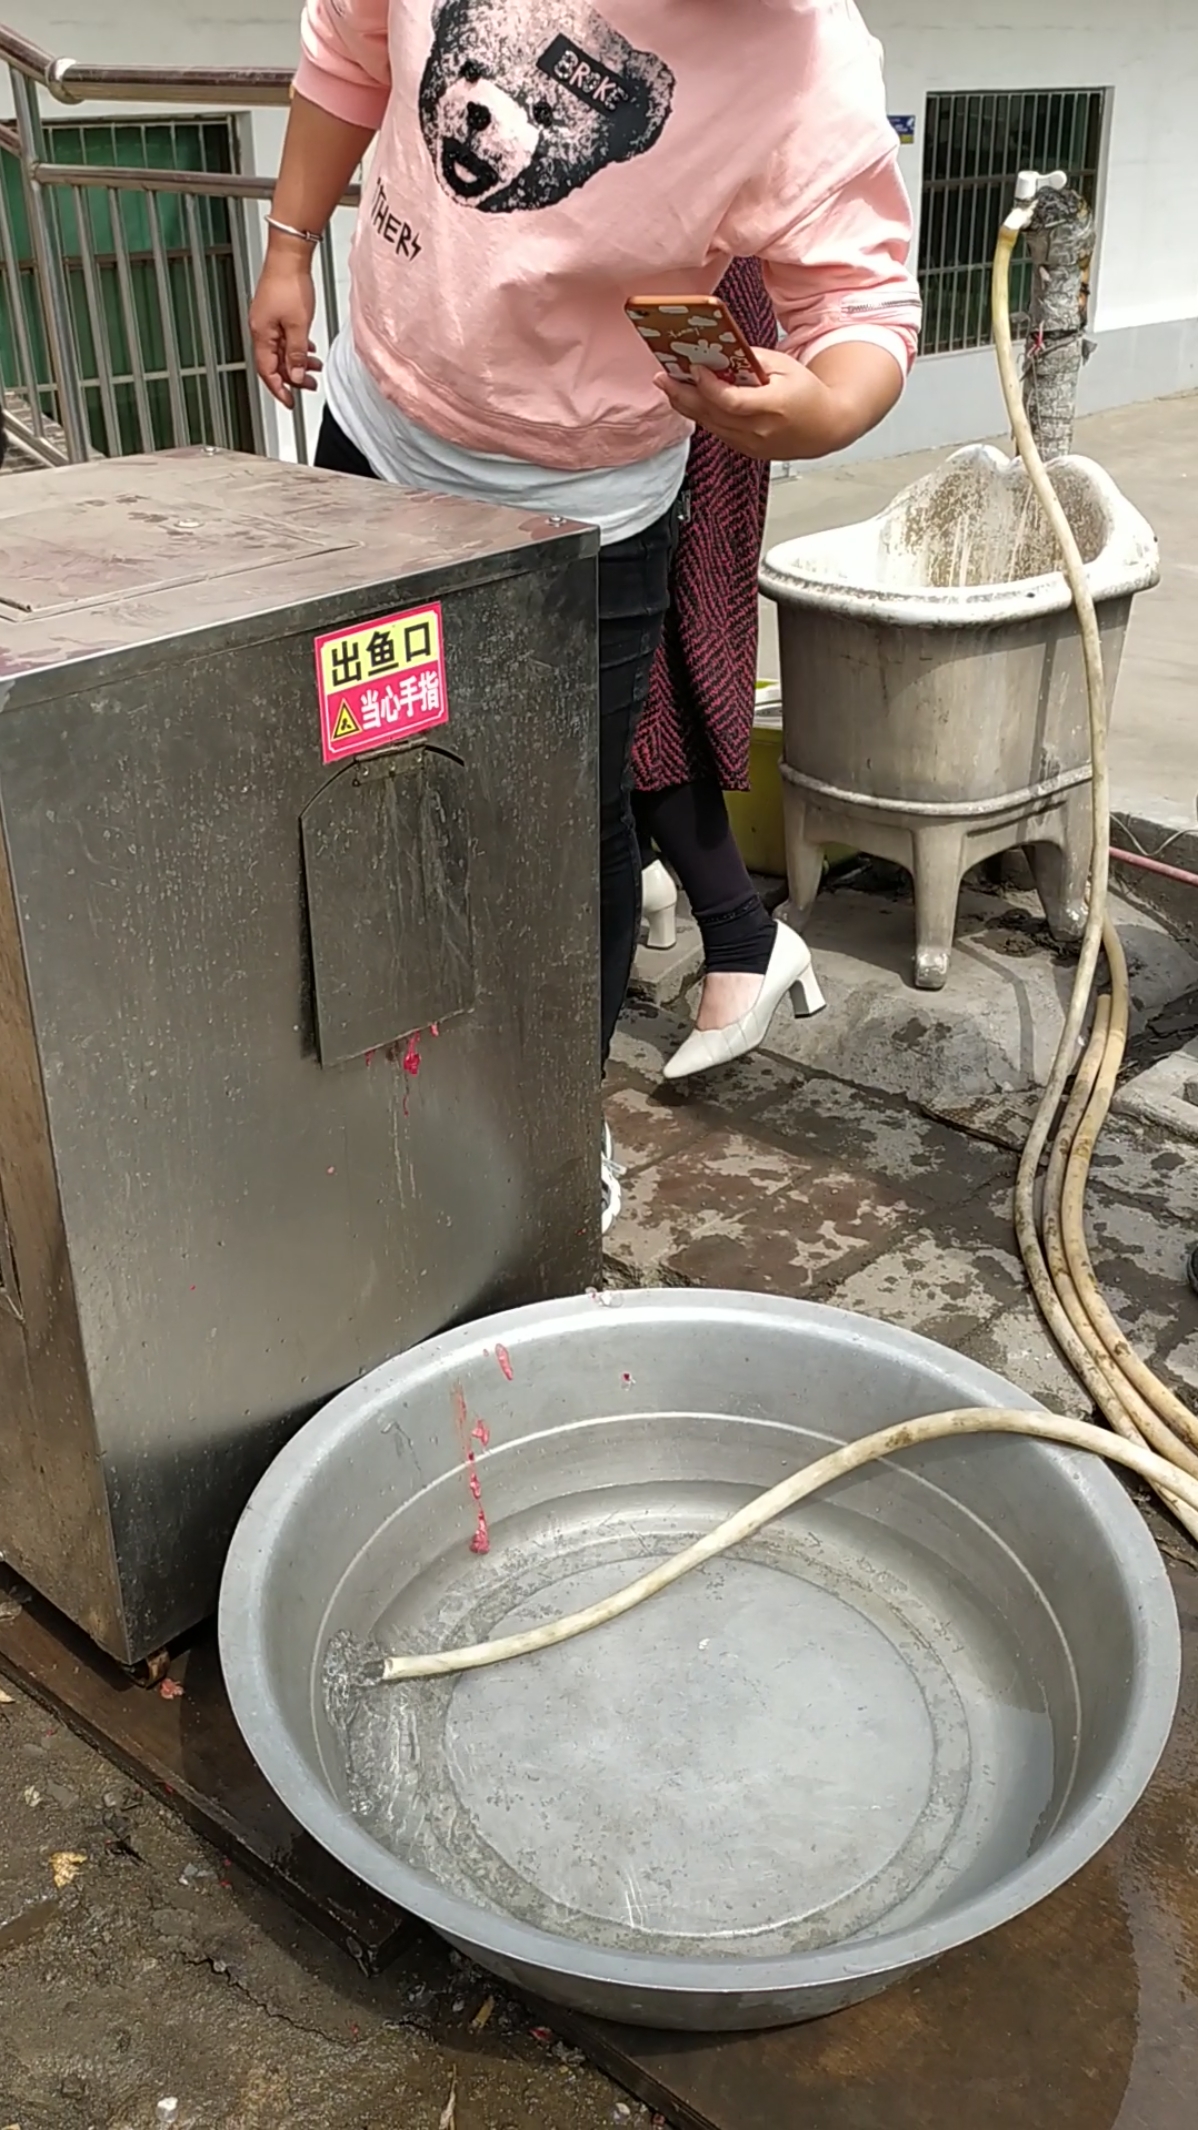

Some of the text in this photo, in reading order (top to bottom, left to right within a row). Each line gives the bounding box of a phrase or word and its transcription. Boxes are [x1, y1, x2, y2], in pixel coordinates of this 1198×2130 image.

[331, 621, 431, 687] 出鱼口
[360, 670, 440, 731] 当心手指
